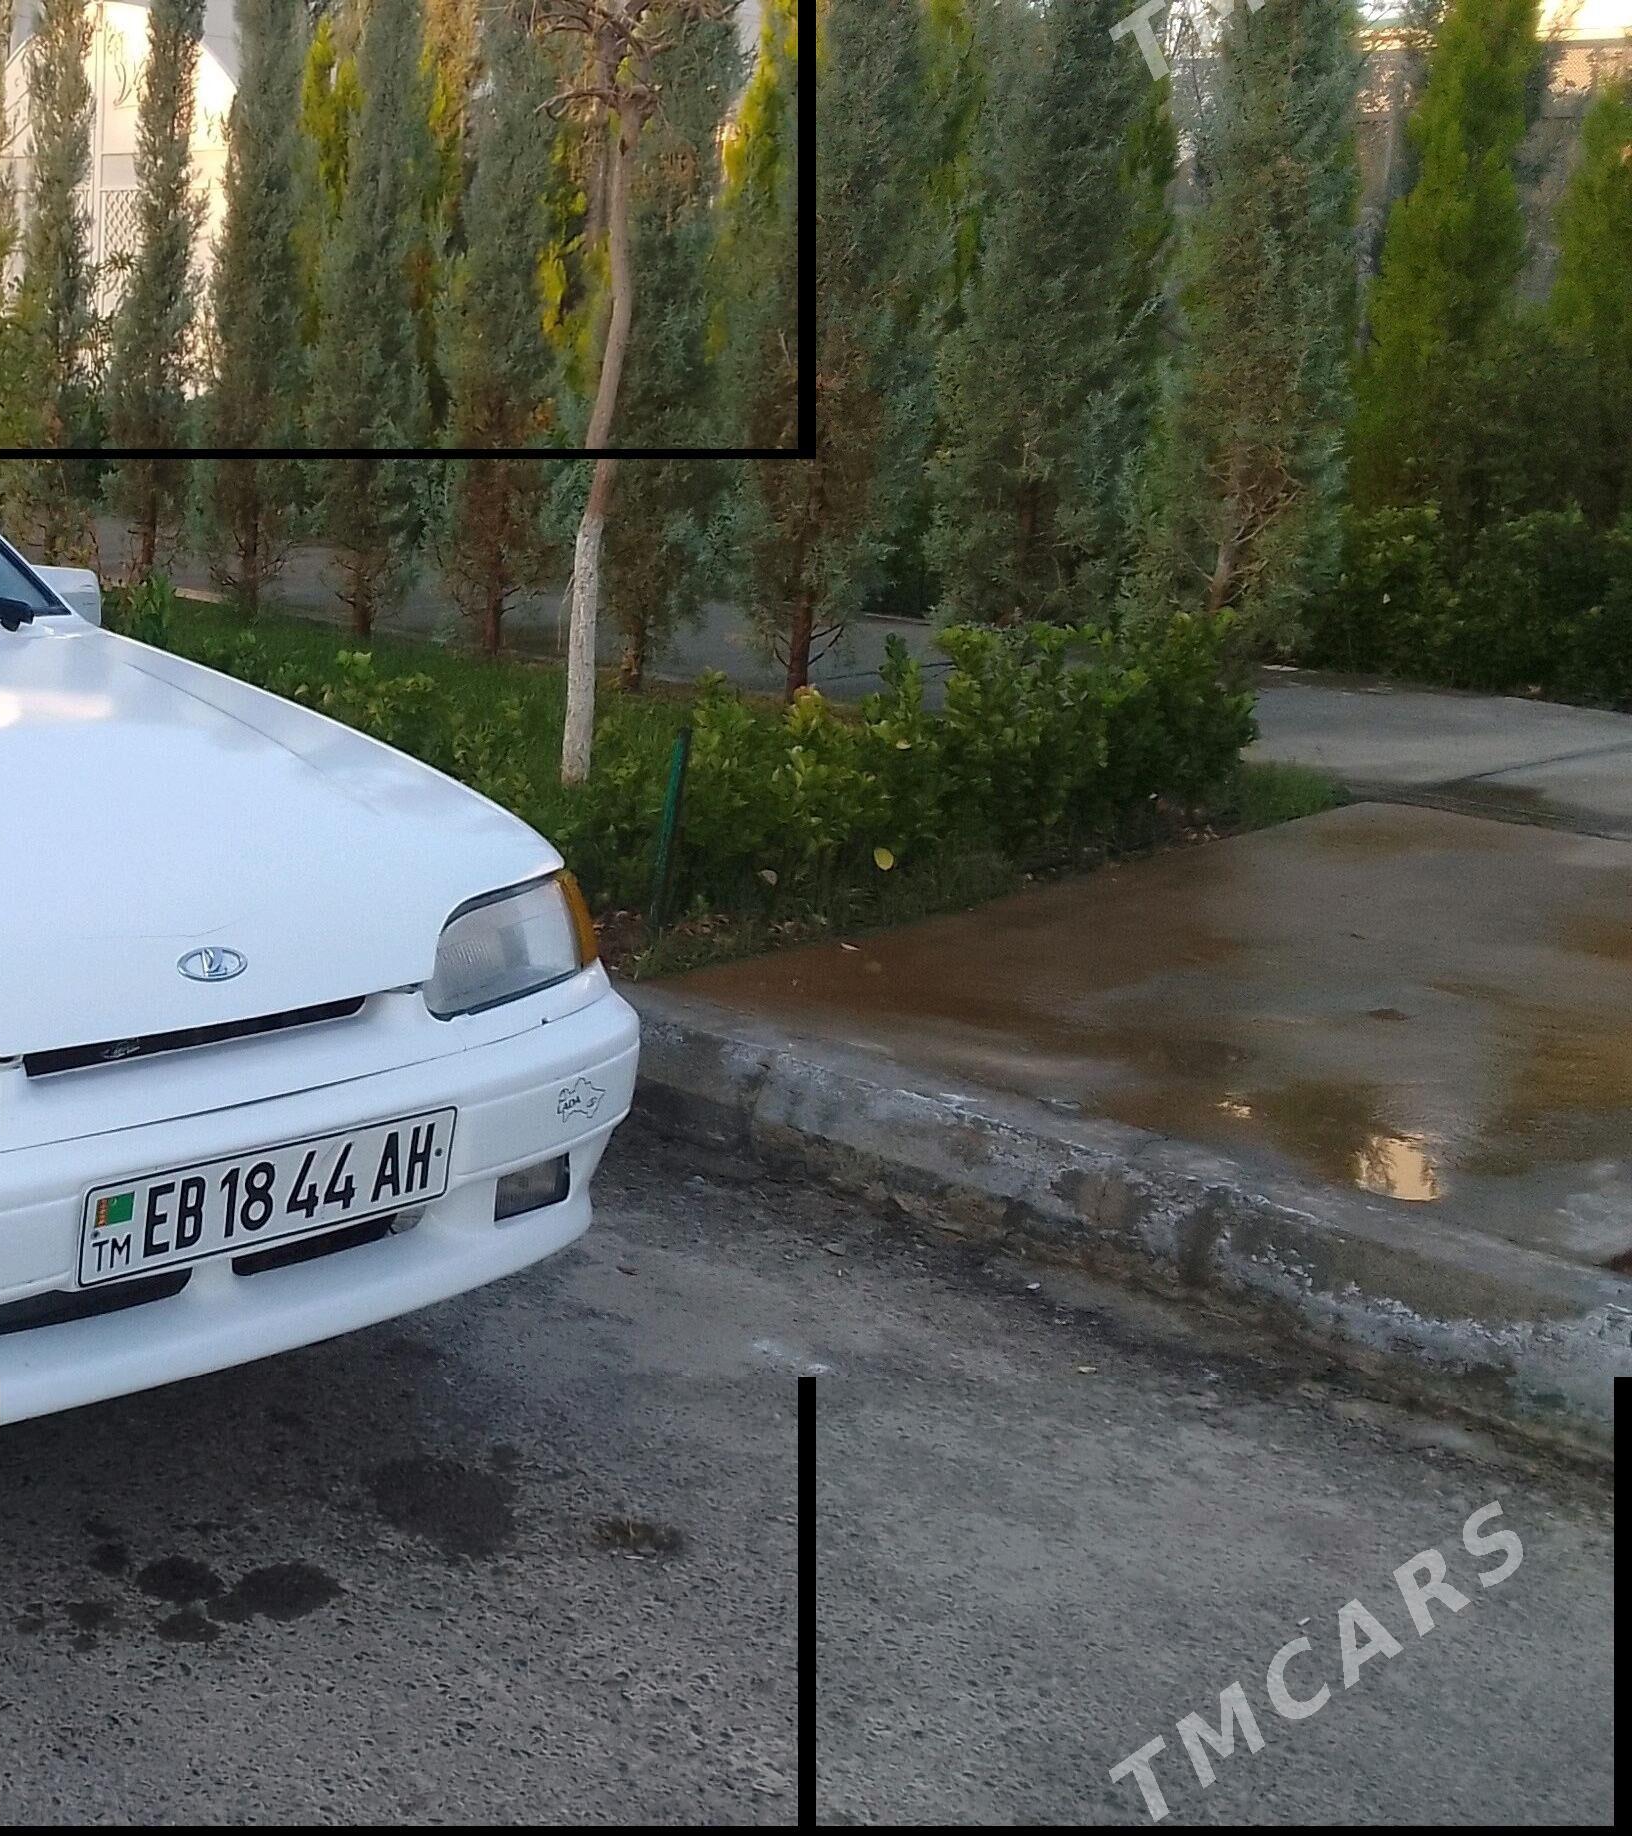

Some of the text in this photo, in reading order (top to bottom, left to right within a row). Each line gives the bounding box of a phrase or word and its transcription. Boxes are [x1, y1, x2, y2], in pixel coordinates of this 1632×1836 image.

[142, 1122, 436, 1258] EB 18 44 AH
[92, 1233, 132, 1272] TM
